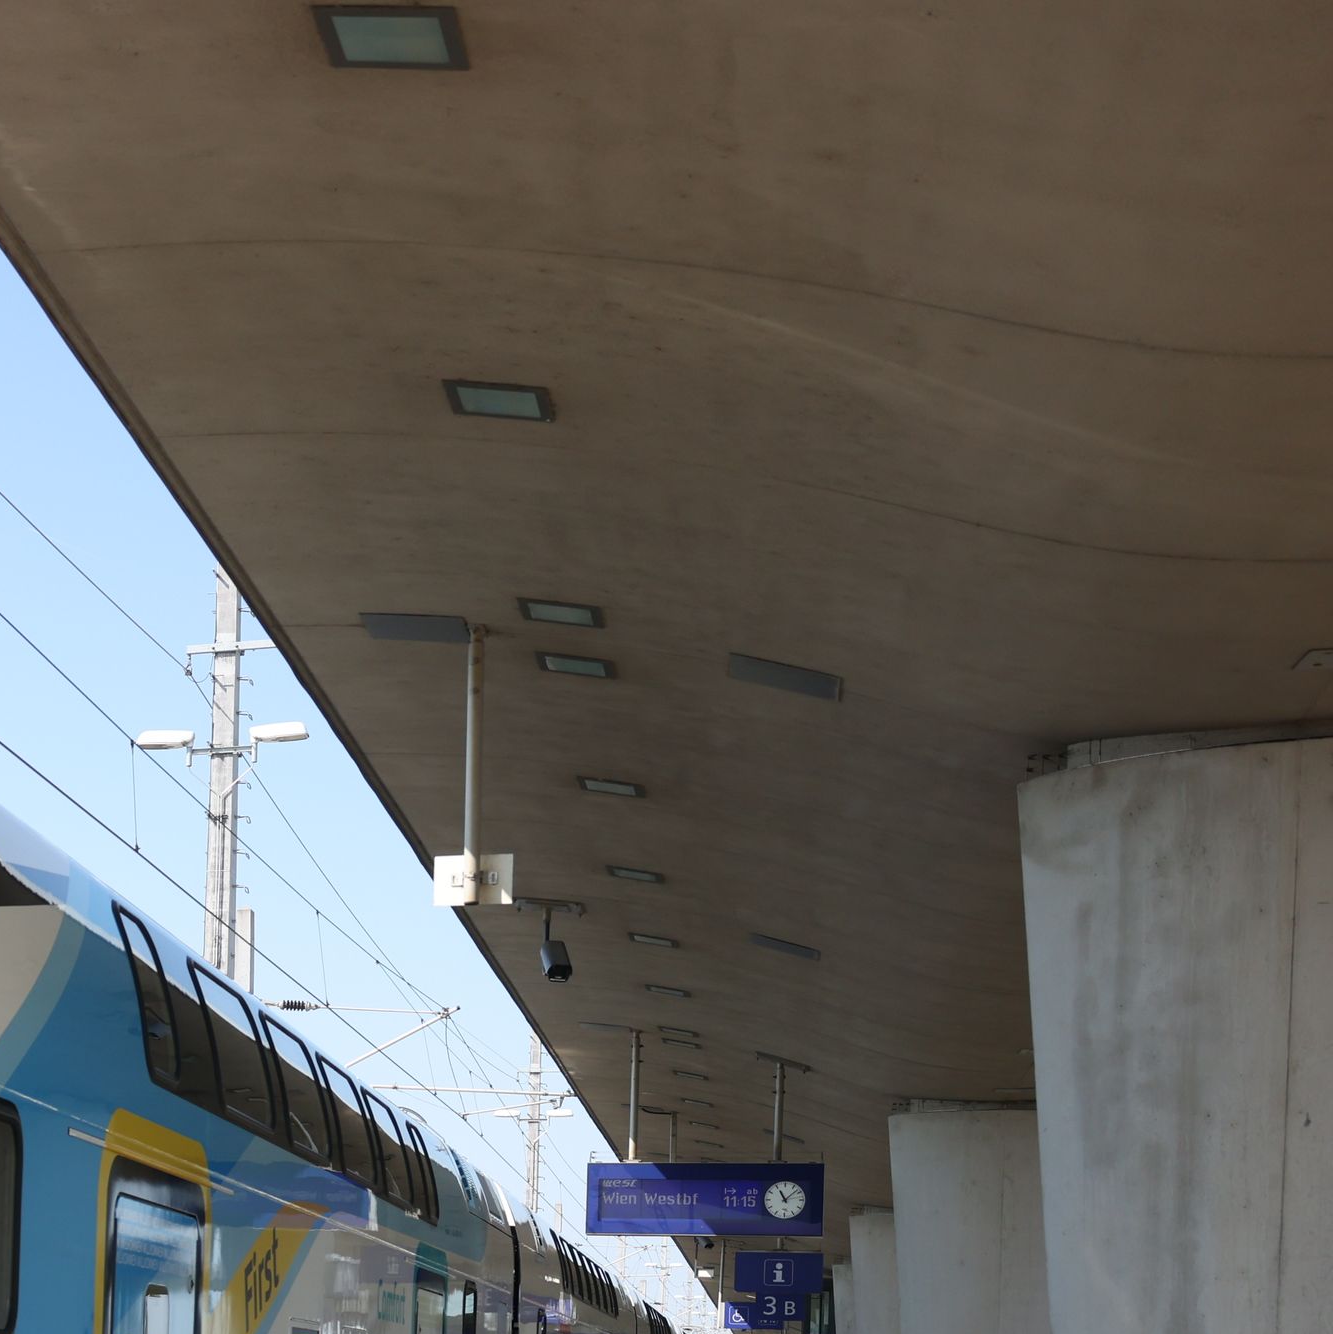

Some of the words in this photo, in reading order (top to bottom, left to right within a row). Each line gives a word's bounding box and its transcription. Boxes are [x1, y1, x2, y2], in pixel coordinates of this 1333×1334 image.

[602, 1192, 637, 1205] Wien
[644, 1192, 699, 1206] Westbf
[723, 1195, 757, 1208] 11:15
[746, 1187, 759, 1195] ab
[244, 1226, 280, 1333] First
[762, 1296, 777, 1316] 3
[784, 1301, 796, 1316] B
